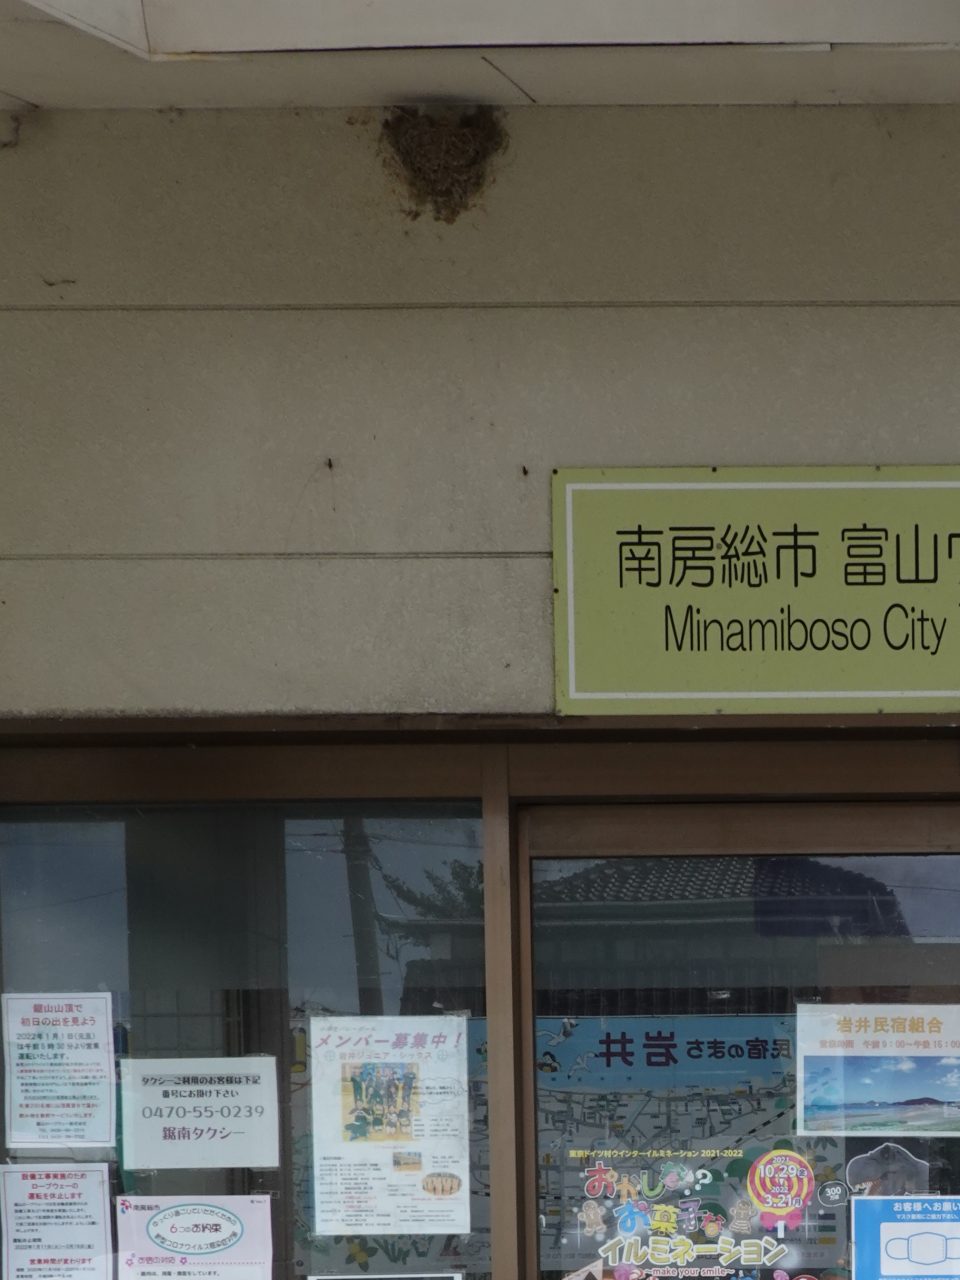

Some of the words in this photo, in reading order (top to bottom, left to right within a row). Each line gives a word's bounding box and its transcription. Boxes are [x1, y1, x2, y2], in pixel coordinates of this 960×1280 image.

[616, 523, 820, 589] 南房総市
[665, 603, 872, 652] Minamiboso
[883, 603, 947, 655] City
[836, 1016, 944, 1034] 岩井民宿組合
[141, 1075, 261, 1086] タクシーご利用のお客様は下記
[162, 1089, 239, 1099] 番号にお掛け下さい
[142, 1105, 265, 1119] 0470-55-0239
[162, 1126, 245, 1141] 鋸南タクシー
[700, 1149, 744, 1158] 2021-2022
[32, 1182, 79, 1190] ロープウェーの
[825, 1186, 842, 1196] 300
[598, 1235, 789, 1267] イルミネーション
[678, 1267, 699, 1277] your
